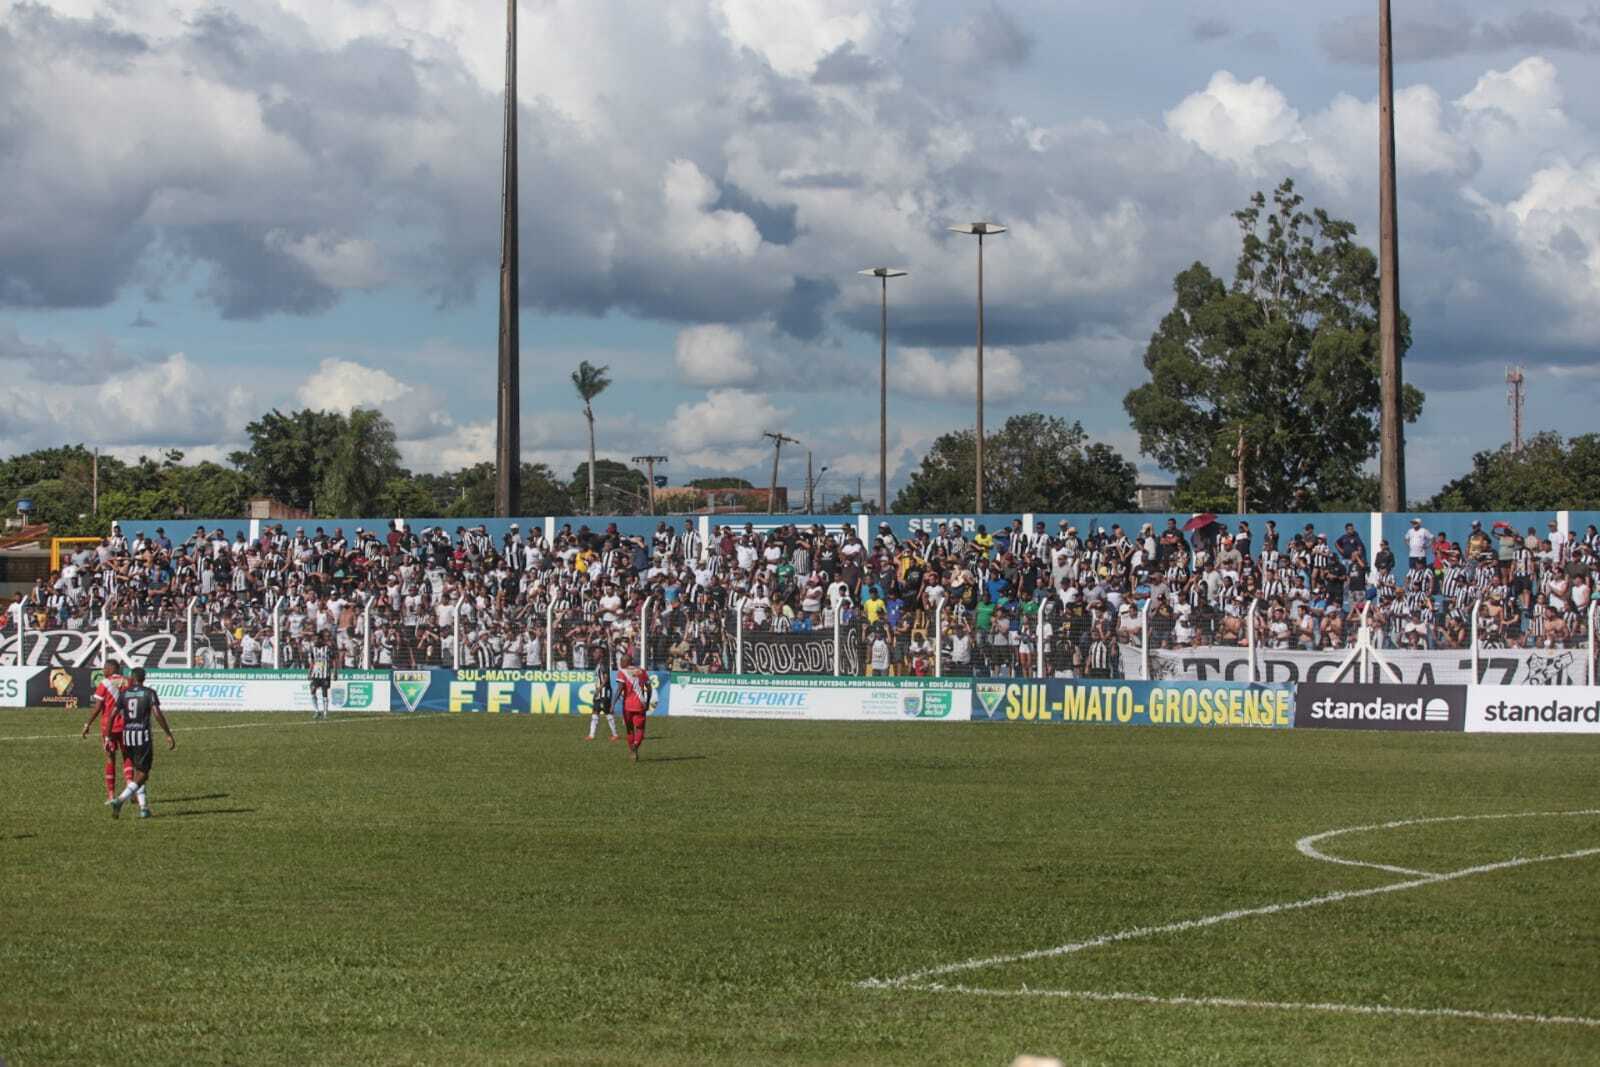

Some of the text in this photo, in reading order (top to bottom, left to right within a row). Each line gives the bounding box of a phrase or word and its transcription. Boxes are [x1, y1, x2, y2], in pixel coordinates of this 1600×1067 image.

[908, 518, 976, 533] SETOR
[457, 670, 595, 682] SUL-MATO-GROSSENS
[695, 690, 808, 706] FUNDESPORTE
[127, 698, 138, 719] 9
[1311, 697, 1423, 721] standard
[1484, 700, 1600, 722] standard
